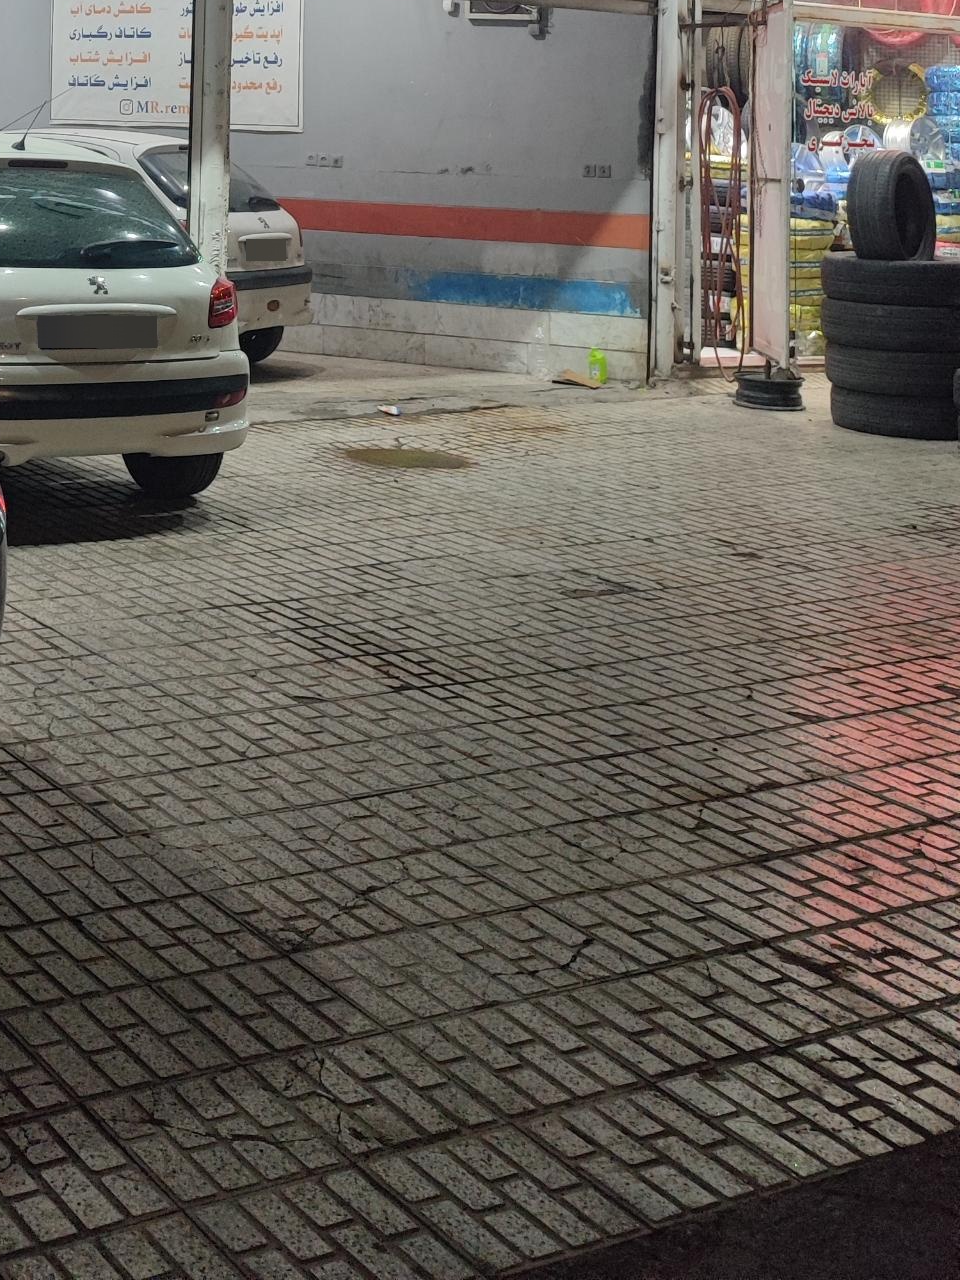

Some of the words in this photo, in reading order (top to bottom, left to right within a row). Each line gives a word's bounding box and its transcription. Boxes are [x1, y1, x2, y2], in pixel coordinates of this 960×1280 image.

[85, 3, 111, 16] دمای
[113, 1, 152, 17] کاهش
[249, 0, 284, 17] افزایش
[69, 51, 100, 65] شتاب
[102, 50, 151, 66] افزایش
[263, 52, 283, 69] رفع
[108, 74, 151, 90] افزایش
[265, 79, 282, 95] رفع
